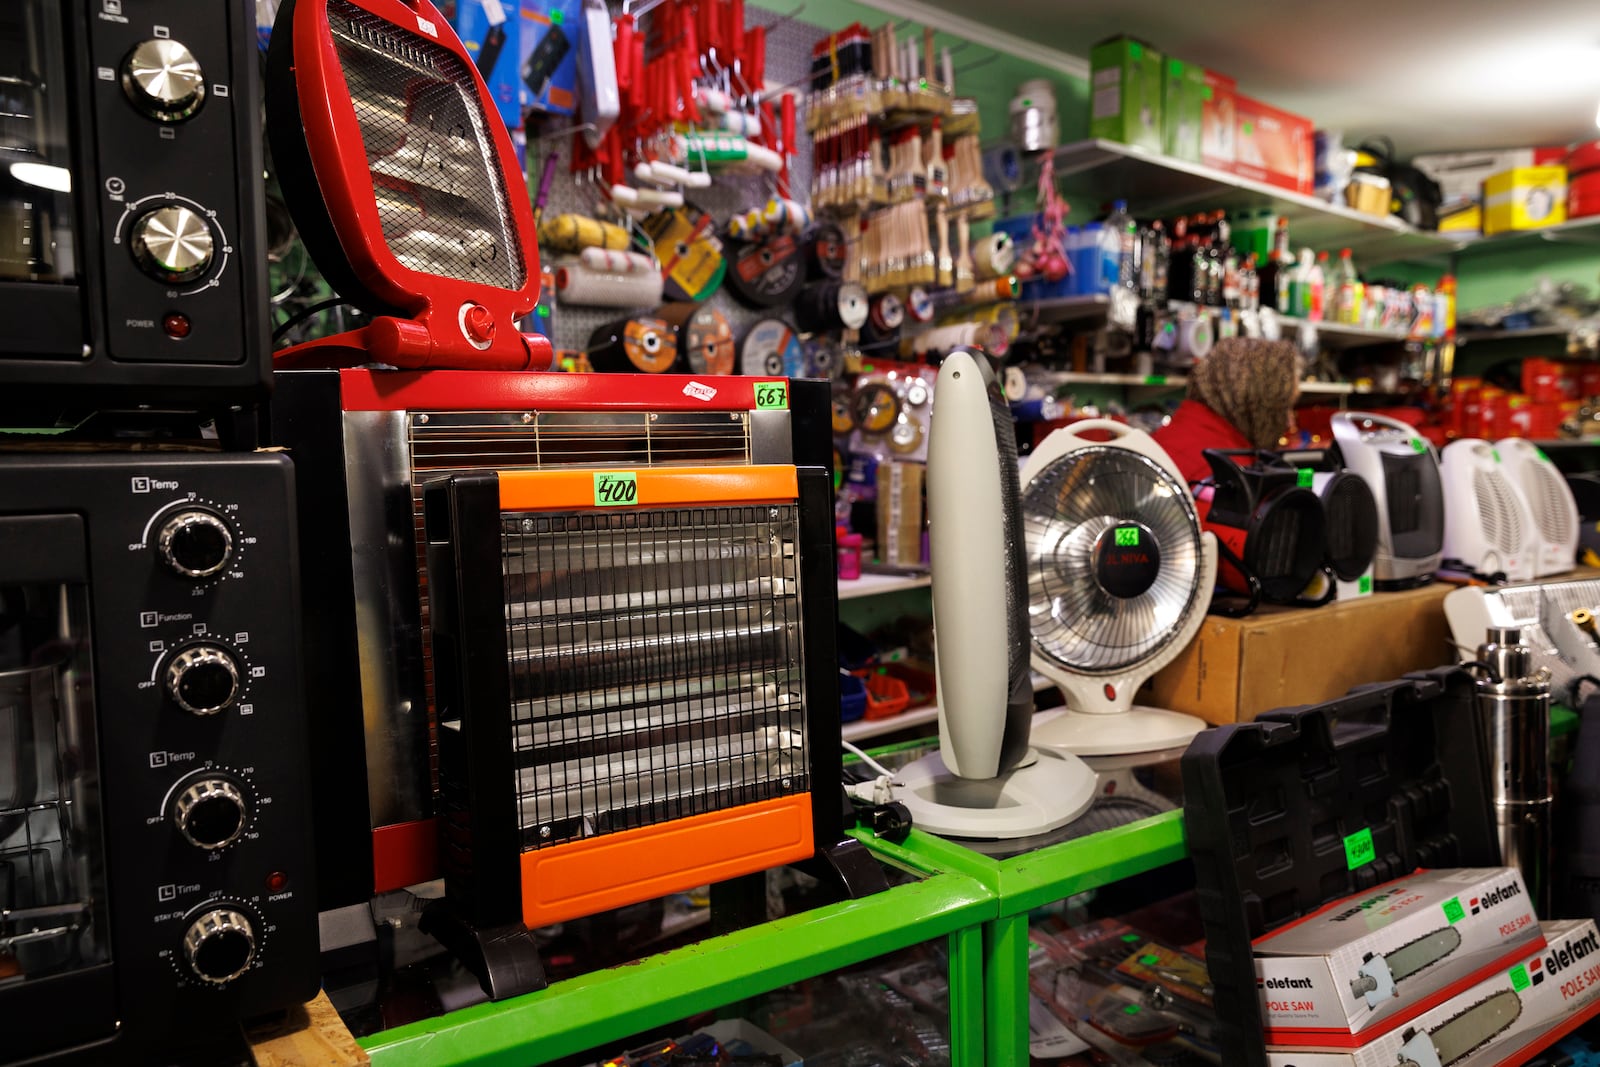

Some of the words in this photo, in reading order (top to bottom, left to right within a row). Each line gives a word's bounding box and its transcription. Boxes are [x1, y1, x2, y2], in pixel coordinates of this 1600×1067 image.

[109, 194, 124, 202] TIME
[165, 192, 176, 200] 20
[126, 203, 137, 211] 10
[206, 210, 217, 218] 30
[114, 235, 121, 244] 0
[222, 246, 233, 254] 40
[209, 279, 220, 287] 50
[166, 290, 178, 298] 60
[126, 319, 154, 328] POWER
[757, 388, 786, 407] 667
[150, 479, 179, 490] Temp
[599, 479, 636, 502] 400
[128, 543, 143, 551] OFF
[158, 613, 192, 622] Function
[137, 682, 153, 690] OFF
[168, 751, 196, 763] Temp
[177, 883, 201, 895] Time
[209, 890, 223, 898] OFF
[268, 892, 293, 902] POWER
[1481, 881, 1521, 909] elefant
[1499, 921, 1517, 937] POLE
[1516, 913, 1532, 929] SAW
[1545, 930, 1599, 976] elefant
[1266, 977, 1313, 989] elefant
[1560, 975, 1586, 1001] POLE
[1266, 1001, 1290, 1011] POLE
[1291, 1001, 1314, 1011] SAW
